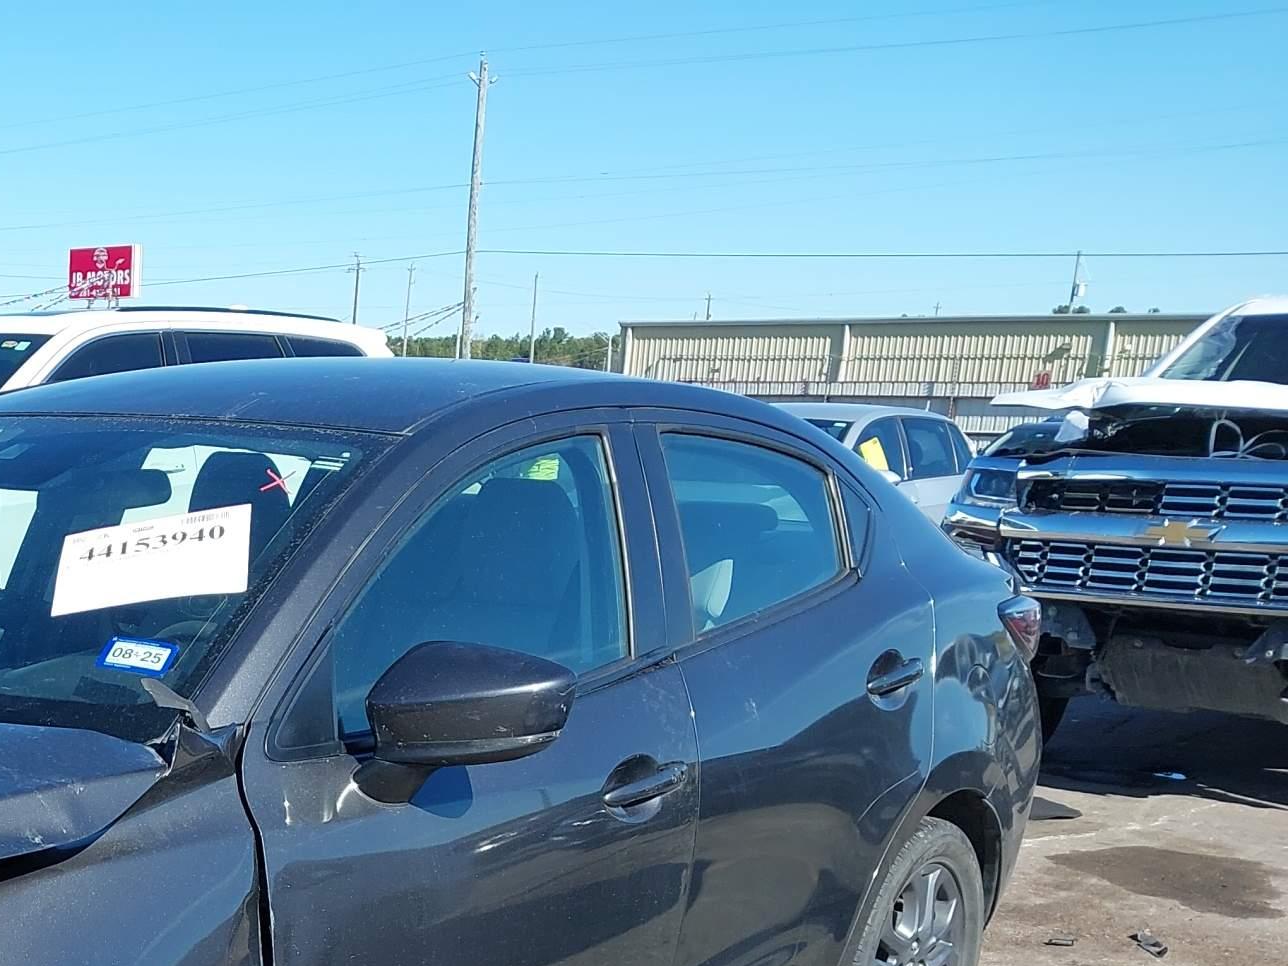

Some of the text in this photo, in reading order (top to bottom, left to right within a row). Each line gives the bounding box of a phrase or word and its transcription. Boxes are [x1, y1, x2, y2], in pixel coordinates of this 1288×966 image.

[71, 269, 130, 287] JB MOTORS
[79, 524, 225, 562] 44153940
